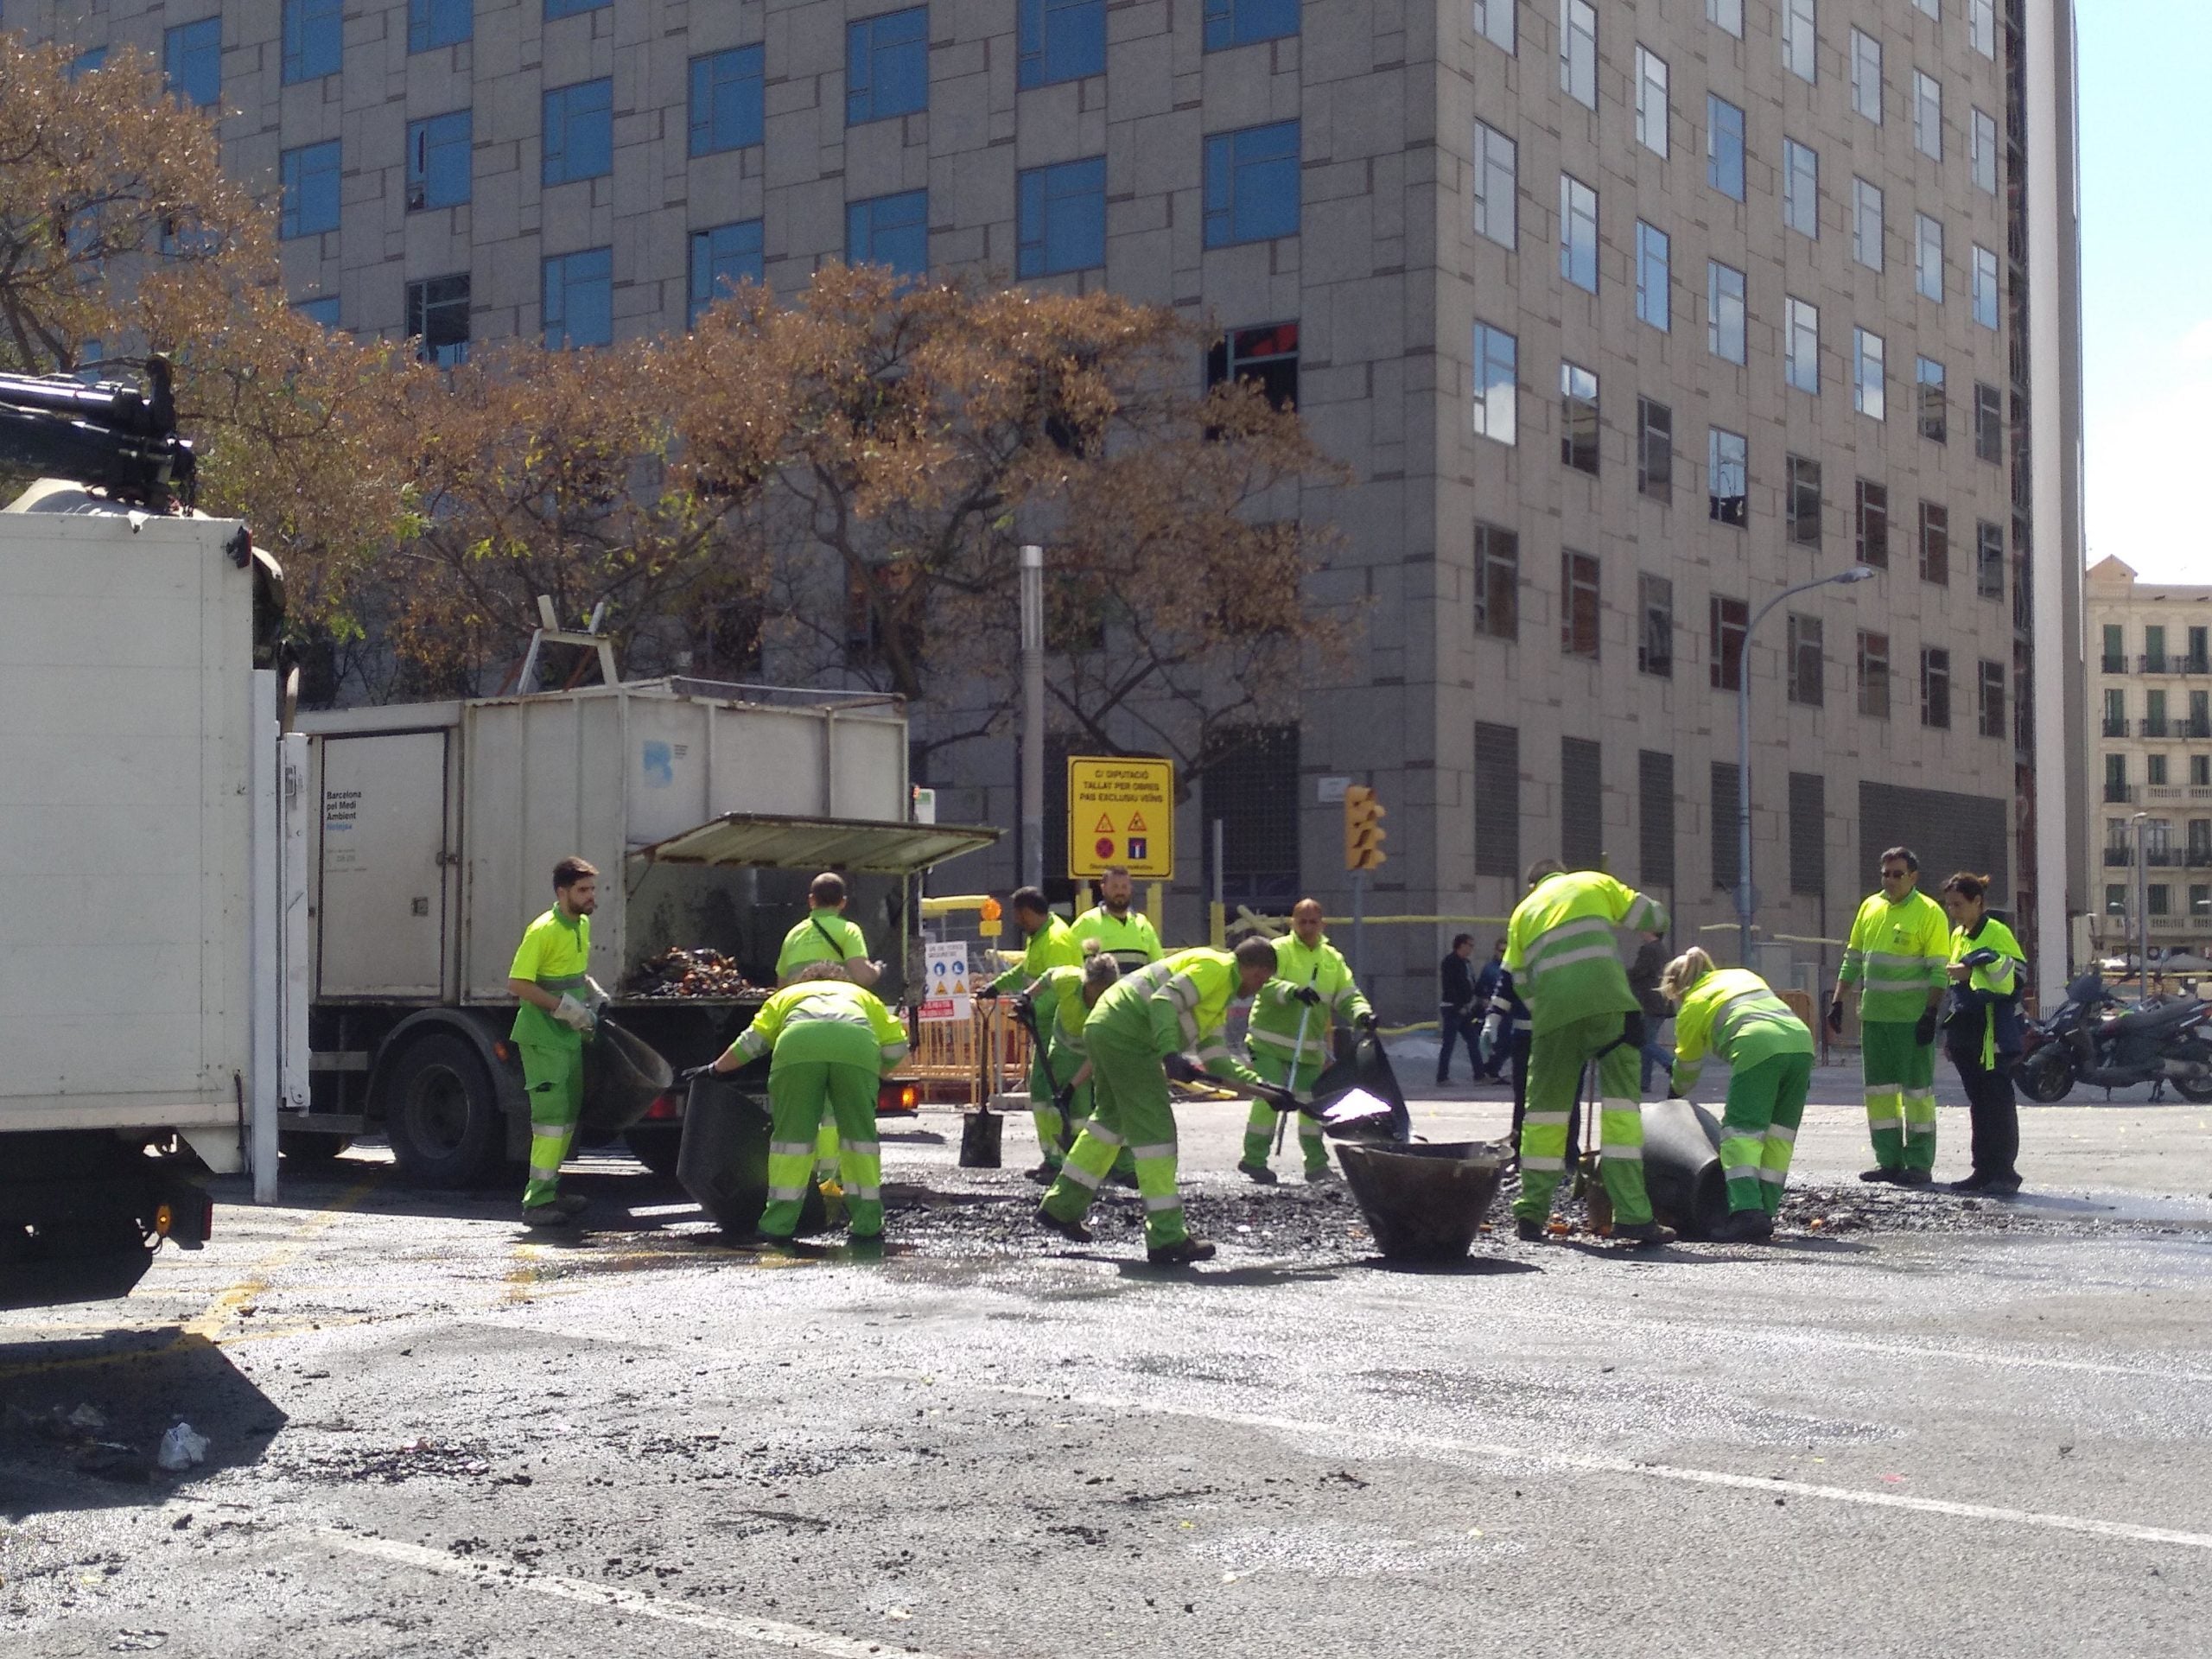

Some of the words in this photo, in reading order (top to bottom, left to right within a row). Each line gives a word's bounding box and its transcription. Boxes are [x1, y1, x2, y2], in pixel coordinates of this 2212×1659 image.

[1084, 781, 1111, 790] TALLAT
[327, 791, 361, 799] Barcelona
[327, 802, 338, 812] pel
